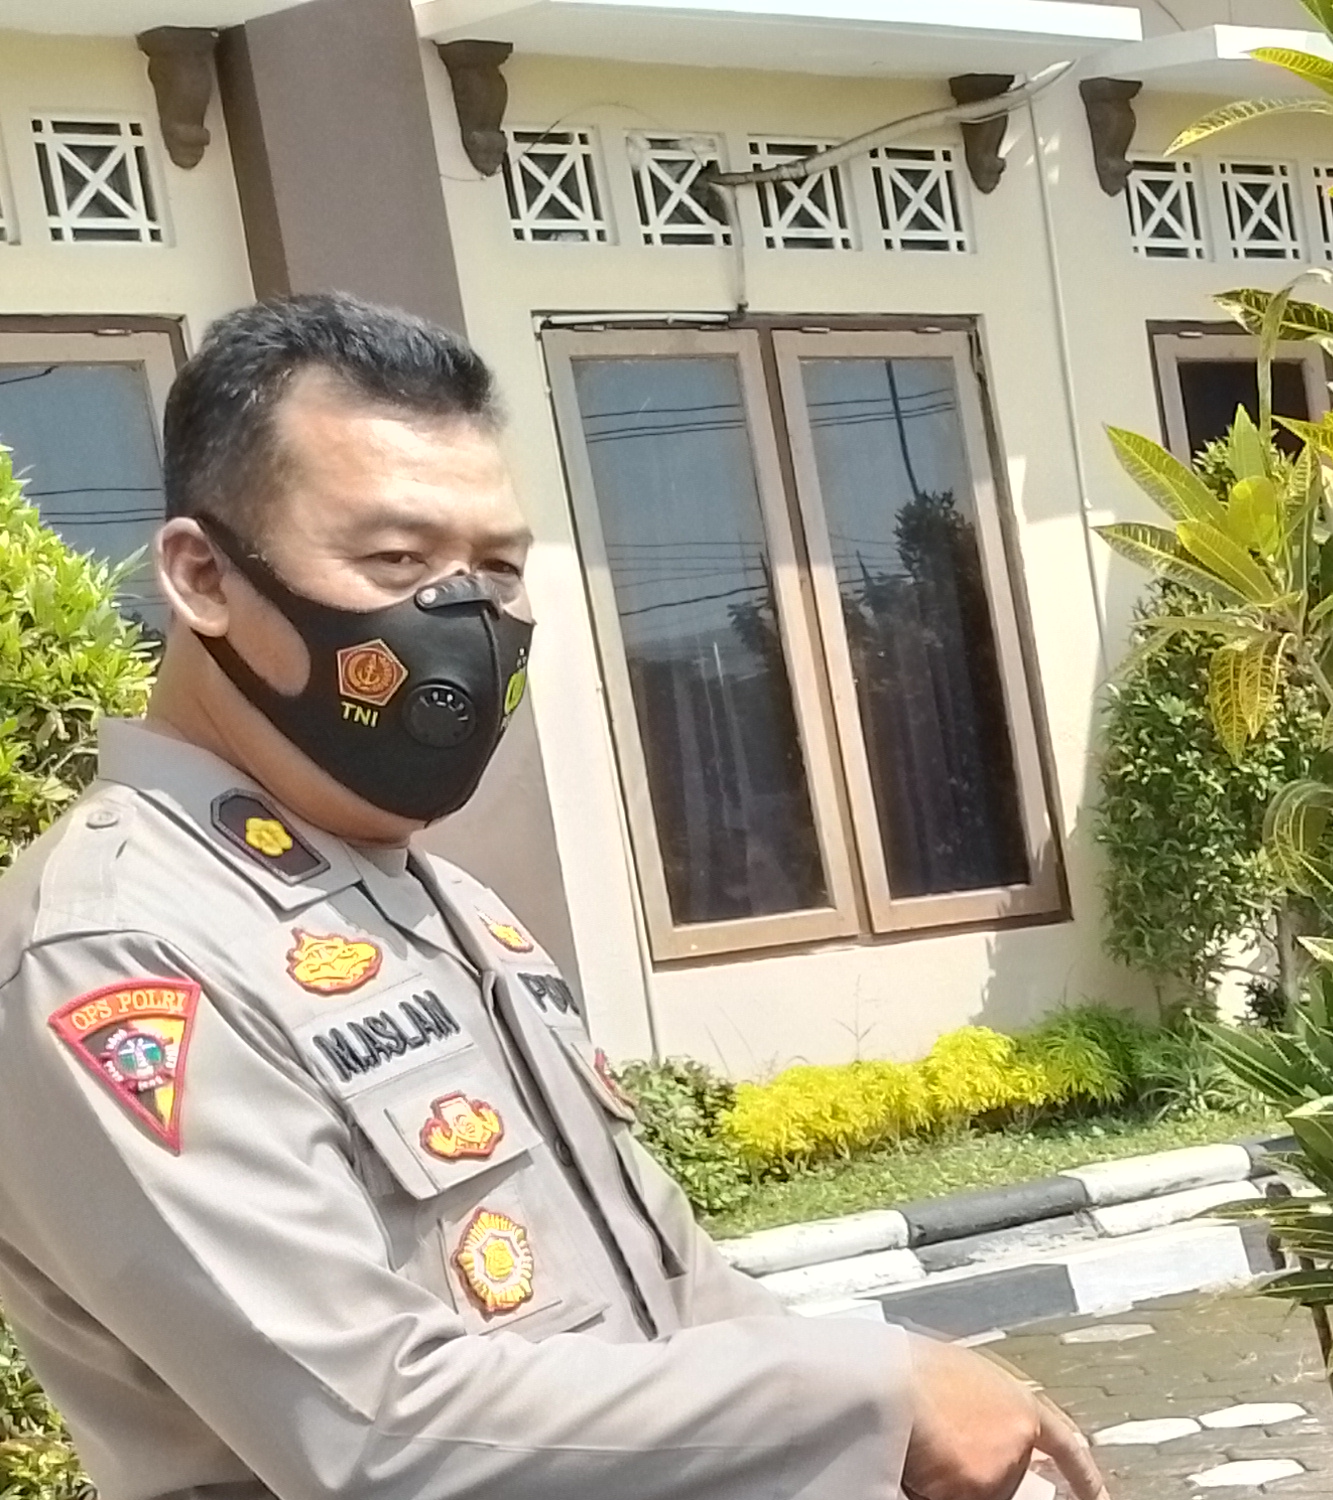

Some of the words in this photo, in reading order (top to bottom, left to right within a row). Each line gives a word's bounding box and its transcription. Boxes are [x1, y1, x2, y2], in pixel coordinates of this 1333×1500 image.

[340, 701, 379, 728] TNI
[71, 998, 112, 1030] OPS
[116, 989, 186, 1014] POLRI
